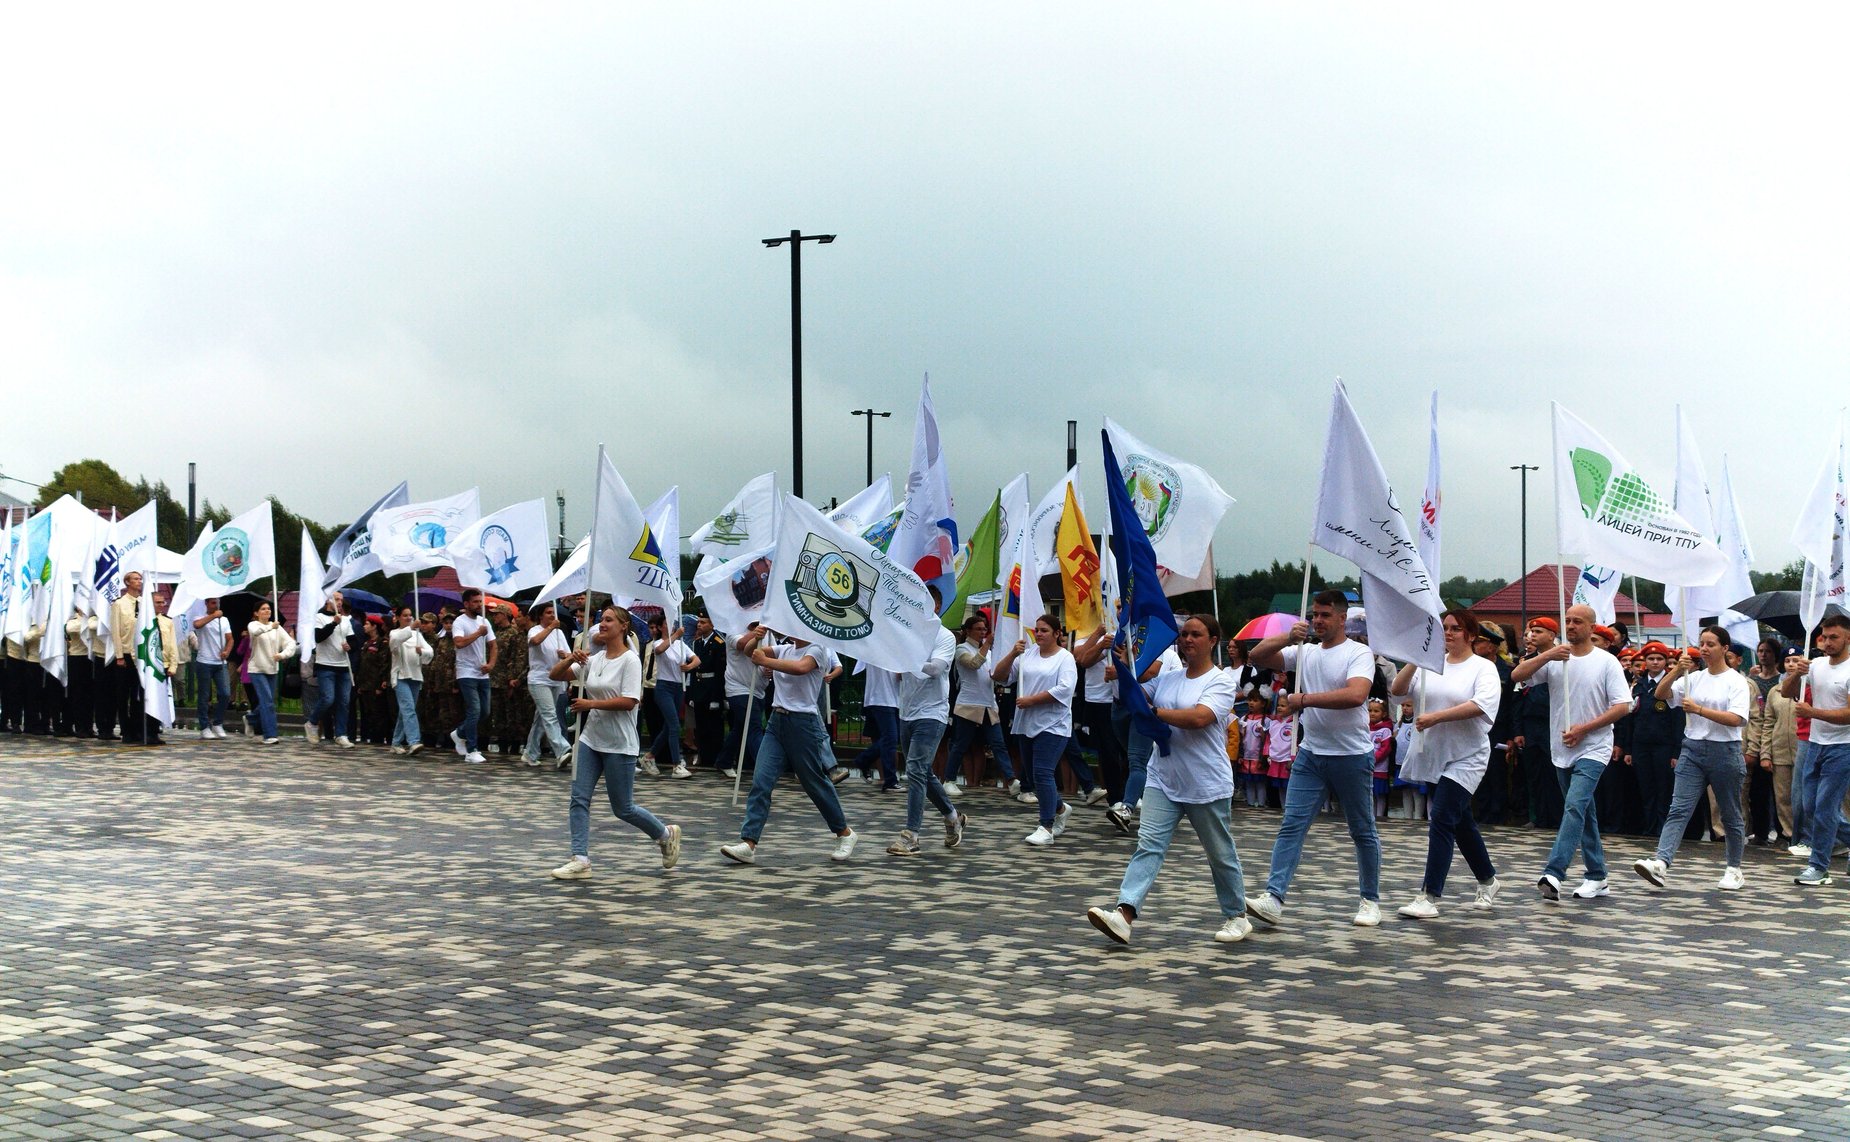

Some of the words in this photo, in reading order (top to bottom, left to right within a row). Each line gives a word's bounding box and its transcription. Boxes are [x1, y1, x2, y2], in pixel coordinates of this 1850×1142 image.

[1597, 514, 1642, 537] ЛИЦЕЙ
[1644, 530, 1672, 545] ПРИ
[1675, 536, 1702, 550] ТПУ
[831, 567, 850, 590] 56
[790, 591, 833, 636] ГИМНАЗИЯ
